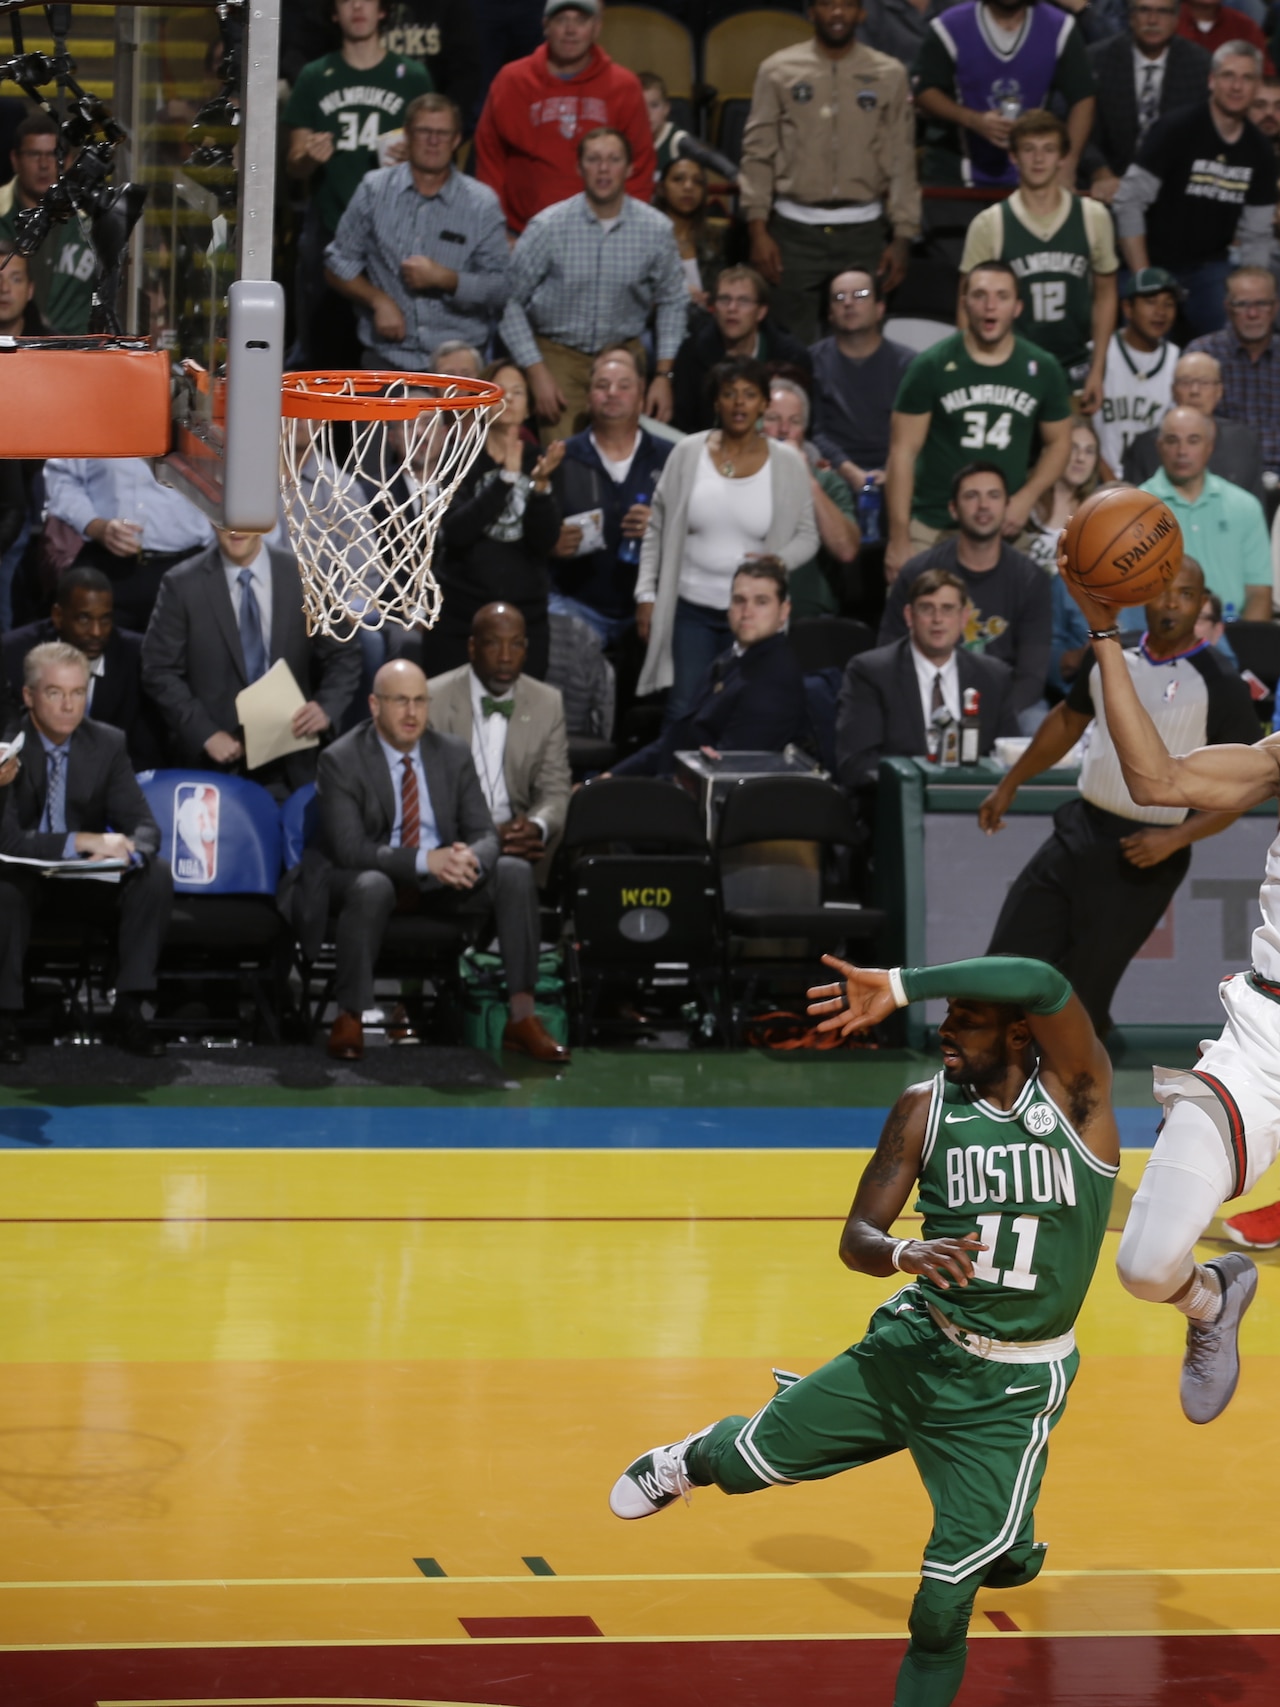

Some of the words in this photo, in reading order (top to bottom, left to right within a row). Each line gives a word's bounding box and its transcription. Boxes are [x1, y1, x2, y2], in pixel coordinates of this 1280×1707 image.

[380, 28, 441, 55] CKS
[336, 112, 380, 151] 34
[1030, 281, 1067, 323] 12
[940, 384, 1038, 417] MILWAUKEE
[960, 411, 1013, 451] 34
[1112, 512, 1177, 577] SPALDING
[621, 887, 672, 907] WCD
[946, 1142, 1077, 1209] BOSTON
[971, 1212, 1040, 1291] 11
